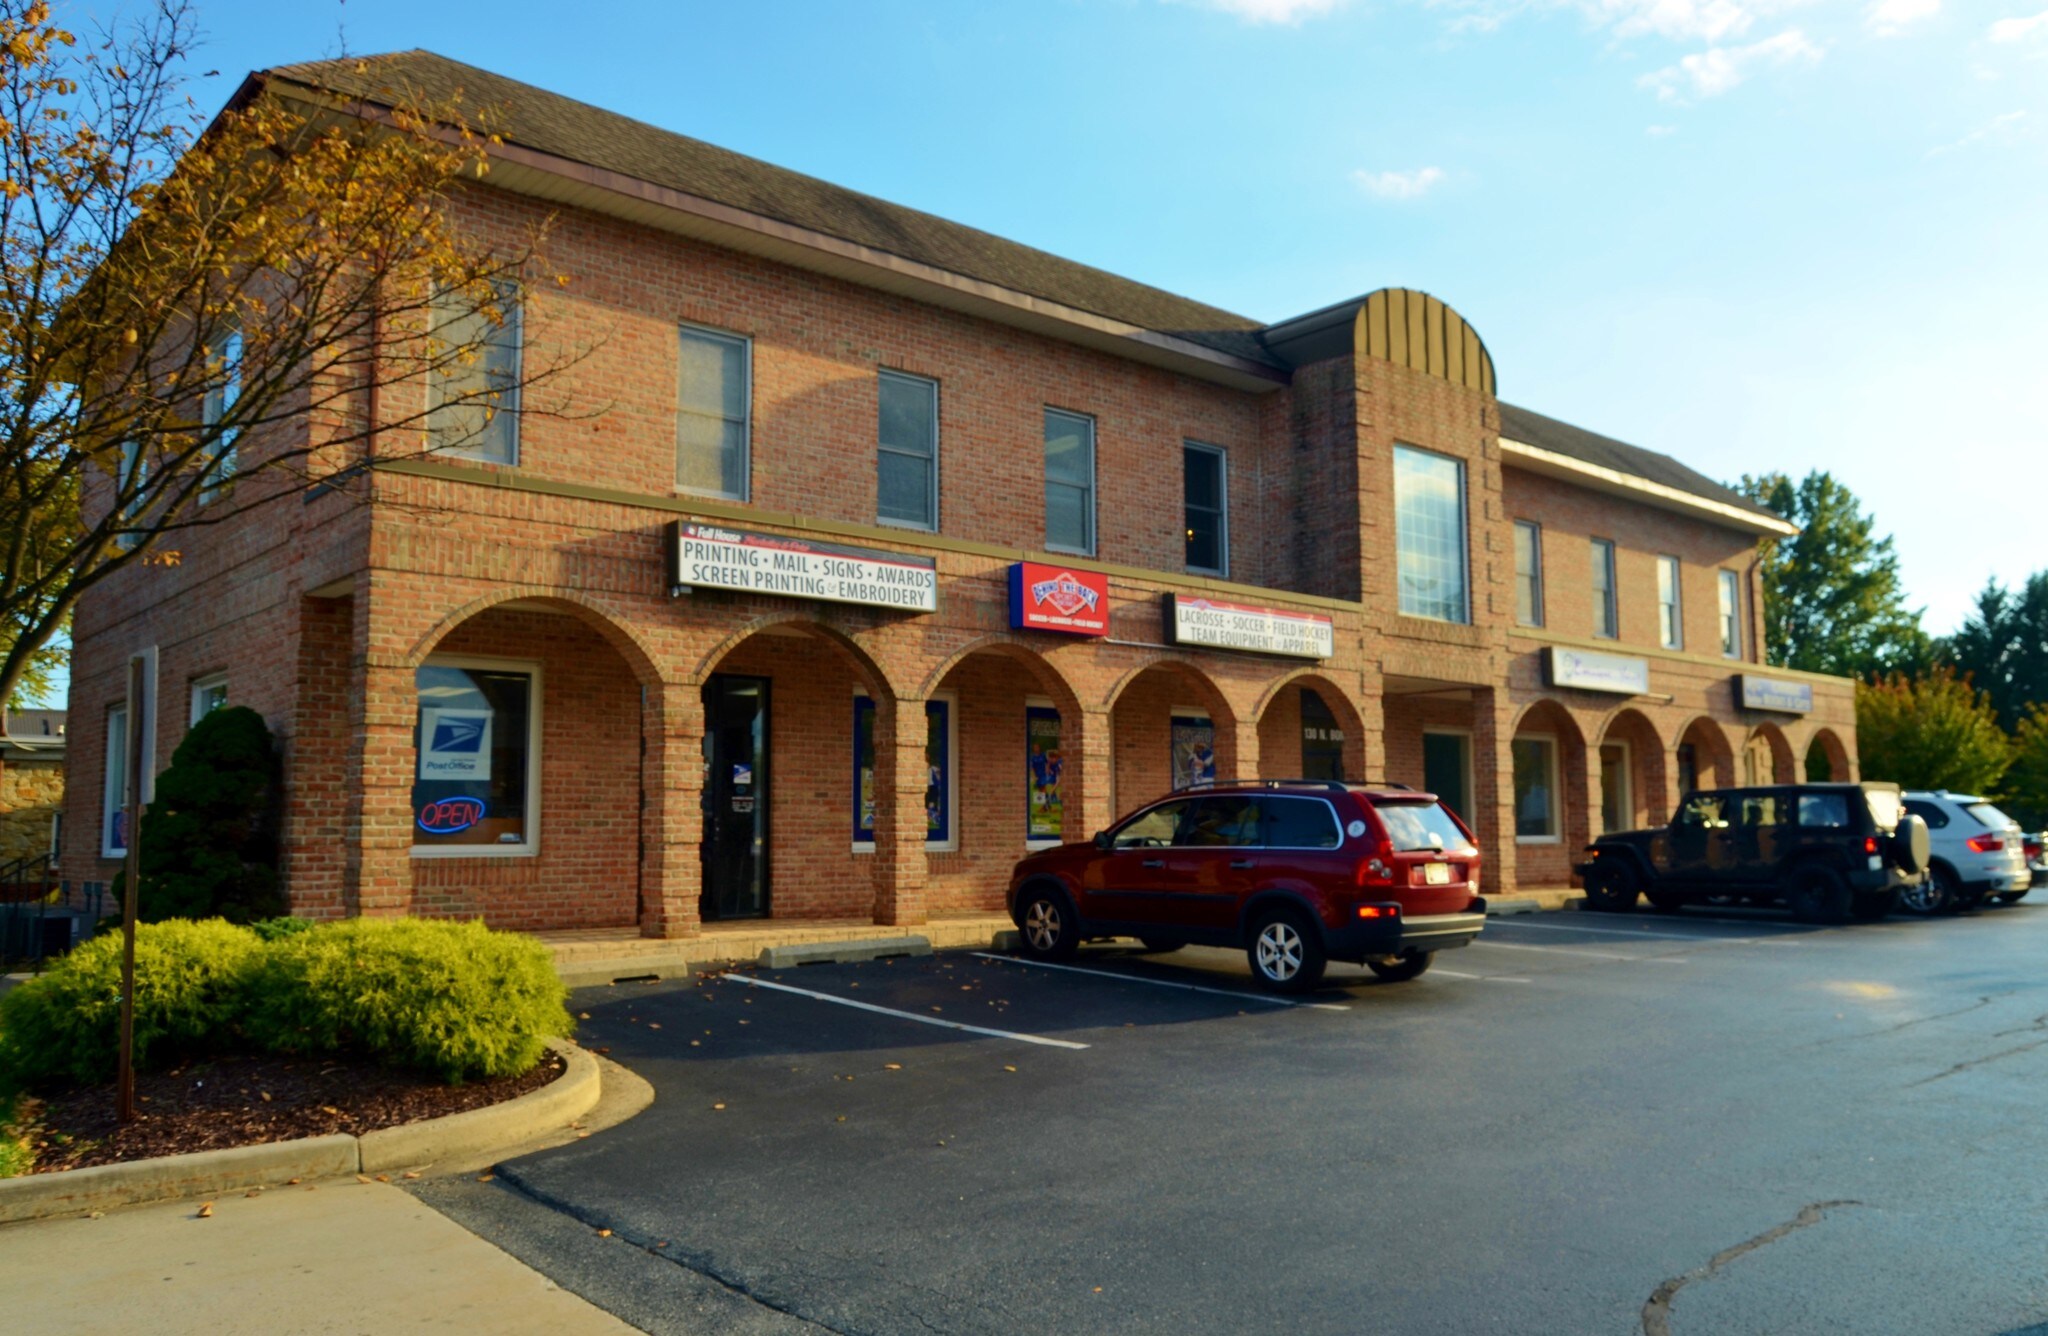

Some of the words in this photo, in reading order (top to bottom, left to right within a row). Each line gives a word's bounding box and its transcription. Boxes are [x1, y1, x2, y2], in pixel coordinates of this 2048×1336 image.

[697, 526, 714, 540] Full
[714, 529, 742, 544] House
[684, 541, 759, 567] PRINTING
[773, 553, 809, 573] MAIL
[823, 560, 863, 580] SIGNS
[876, 566, 932, 588] AWARDS
[692, 564, 749, 586] SCREEN
[755, 571, 825, 595] PRINTING
[839, 581, 926, 606] EMBROIDERY
[1062, 581, 1076, 593] THE
[1179, 609, 1225, 628] LACROSSE
[1233, 616, 1265, 633] SOCCER
[1273, 621, 1297, 637] FIELD
[1299, 625, 1330, 640] HOCKEY
[1191, 627, 1217, 643] TEAM
[1220, 630, 1274, 649] EQUIPMENT
[1282, 638, 1321, 655] APPAREL
[426, 761, 449, 770] Post
[448, 760, 476, 770] Office
[421, 803, 480, 826] OPEN
